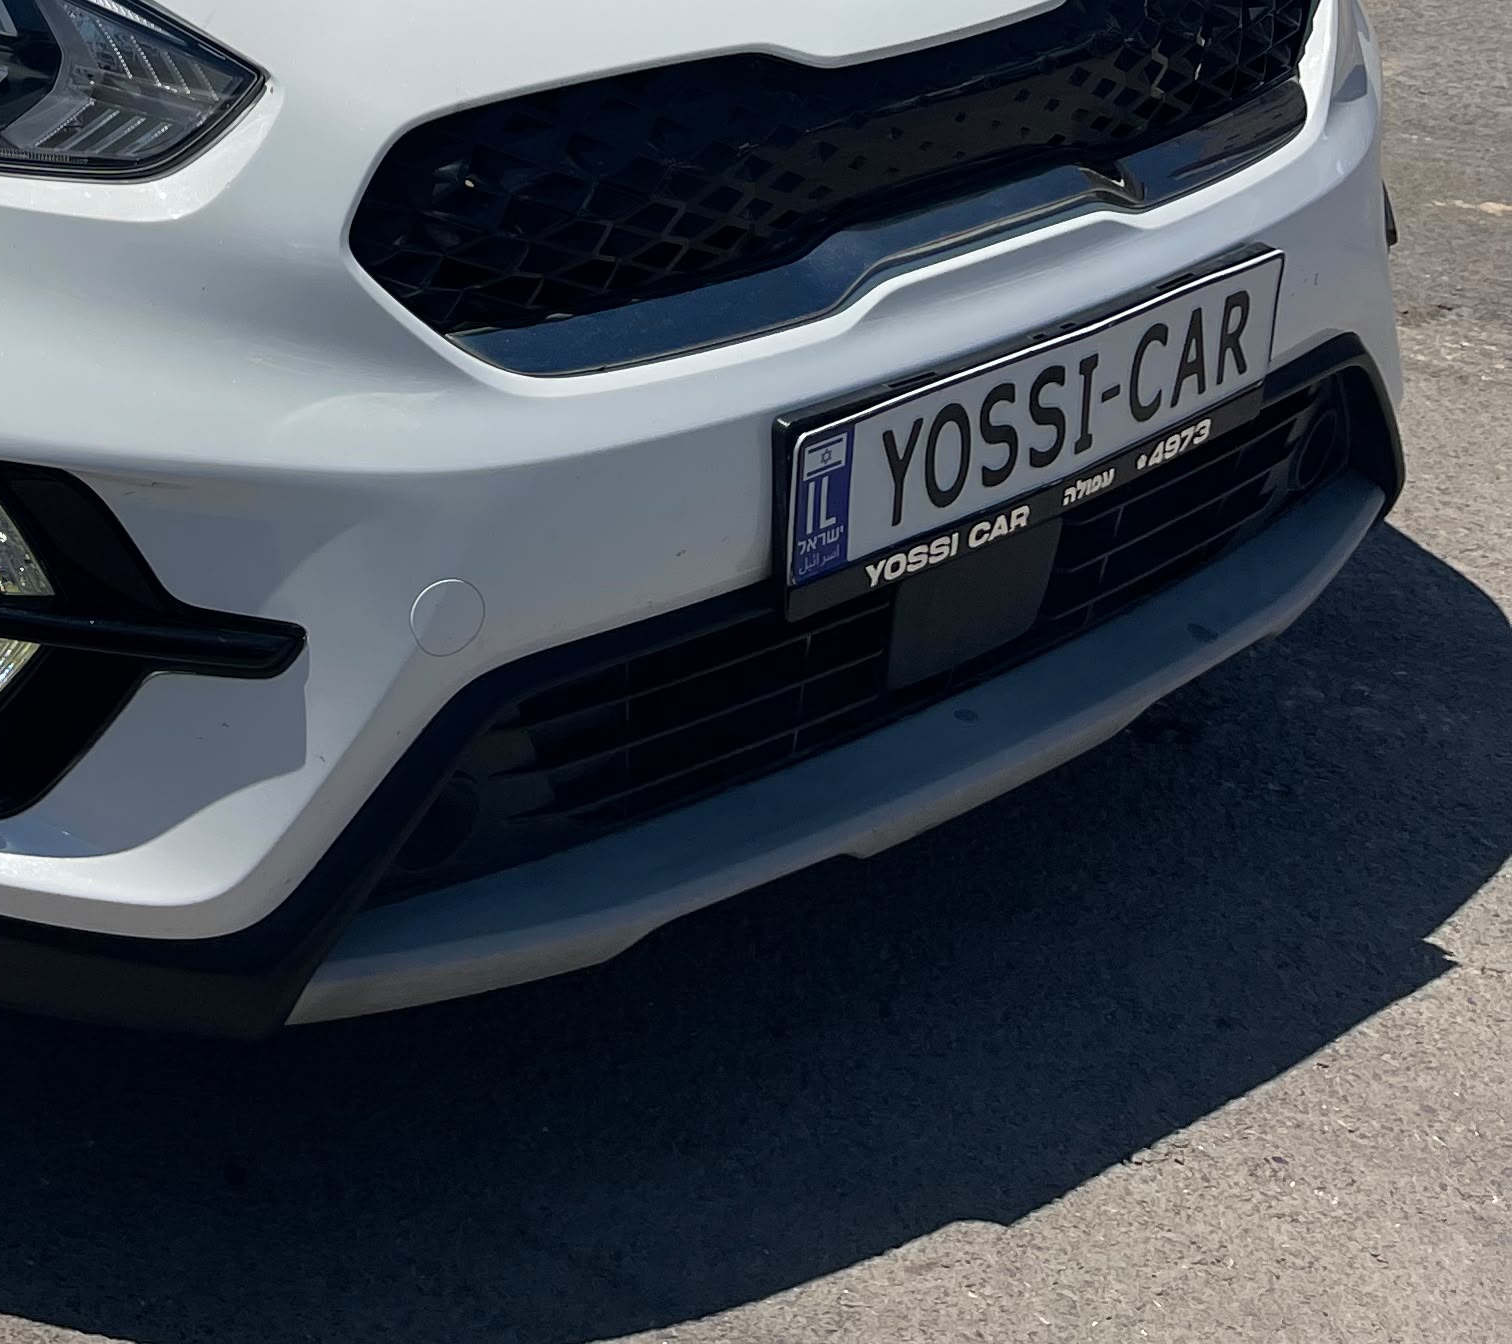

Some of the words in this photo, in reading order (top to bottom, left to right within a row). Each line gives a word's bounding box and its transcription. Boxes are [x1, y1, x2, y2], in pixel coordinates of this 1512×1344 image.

[882, 290, 1250, 526] YOSSI-CAR
[797, 525, 844, 556] ישראל
[806, 475, 836, 535] IL
[865, 529, 959, 588] YOSSI
[968, 505, 1030, 550] CAR
[1064, 467, 1115, 507] עפולה
